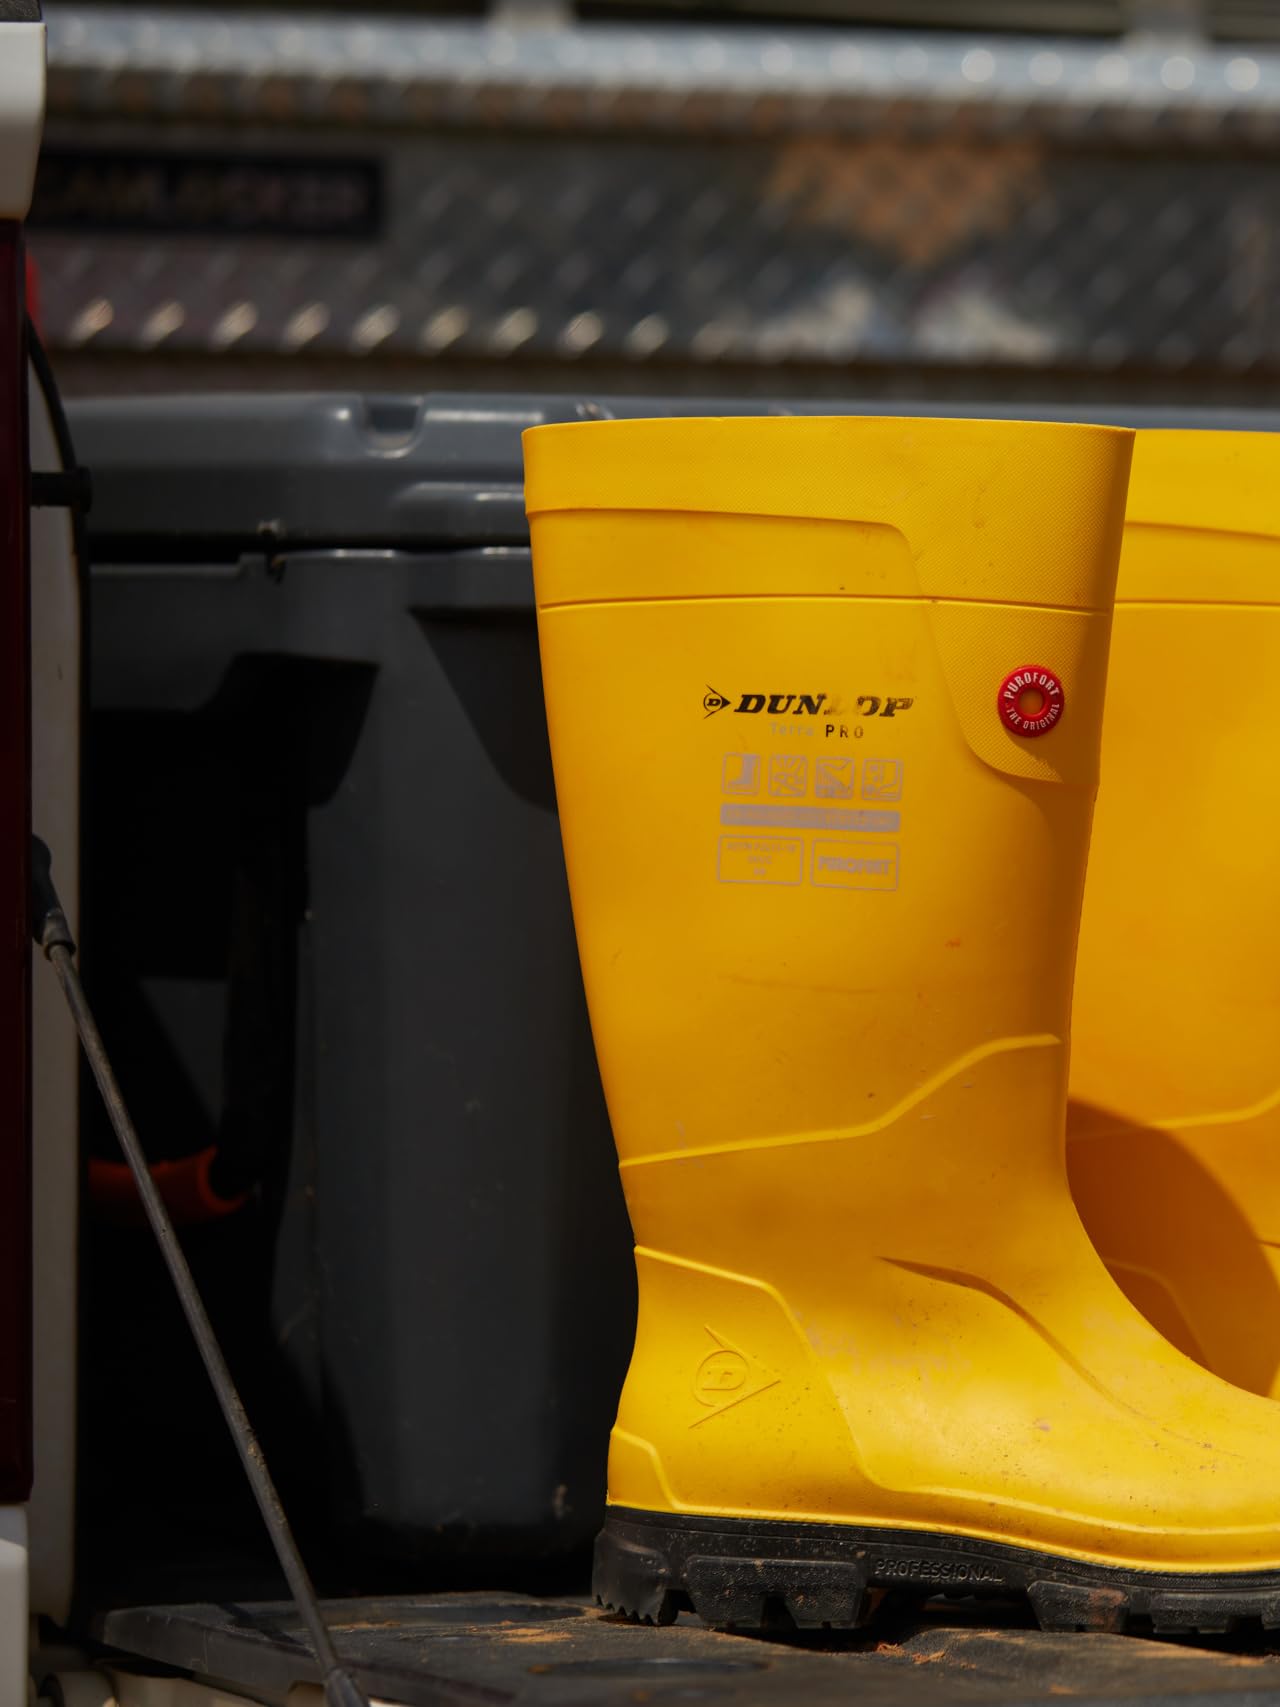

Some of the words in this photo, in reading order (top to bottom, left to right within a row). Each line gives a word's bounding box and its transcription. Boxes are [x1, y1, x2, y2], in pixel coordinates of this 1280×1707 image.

[1003, 672, 1060, 699] PUROFORT
[734, 692, 915, 718] DUNOP
[1006, 706, 1022, 725] THE
[1023, 703, 1060, 730] ORIGINAL
[825, 724, 865, 739] PRO
[873, 1558, 1006, 1583] PROFESSIONAL
